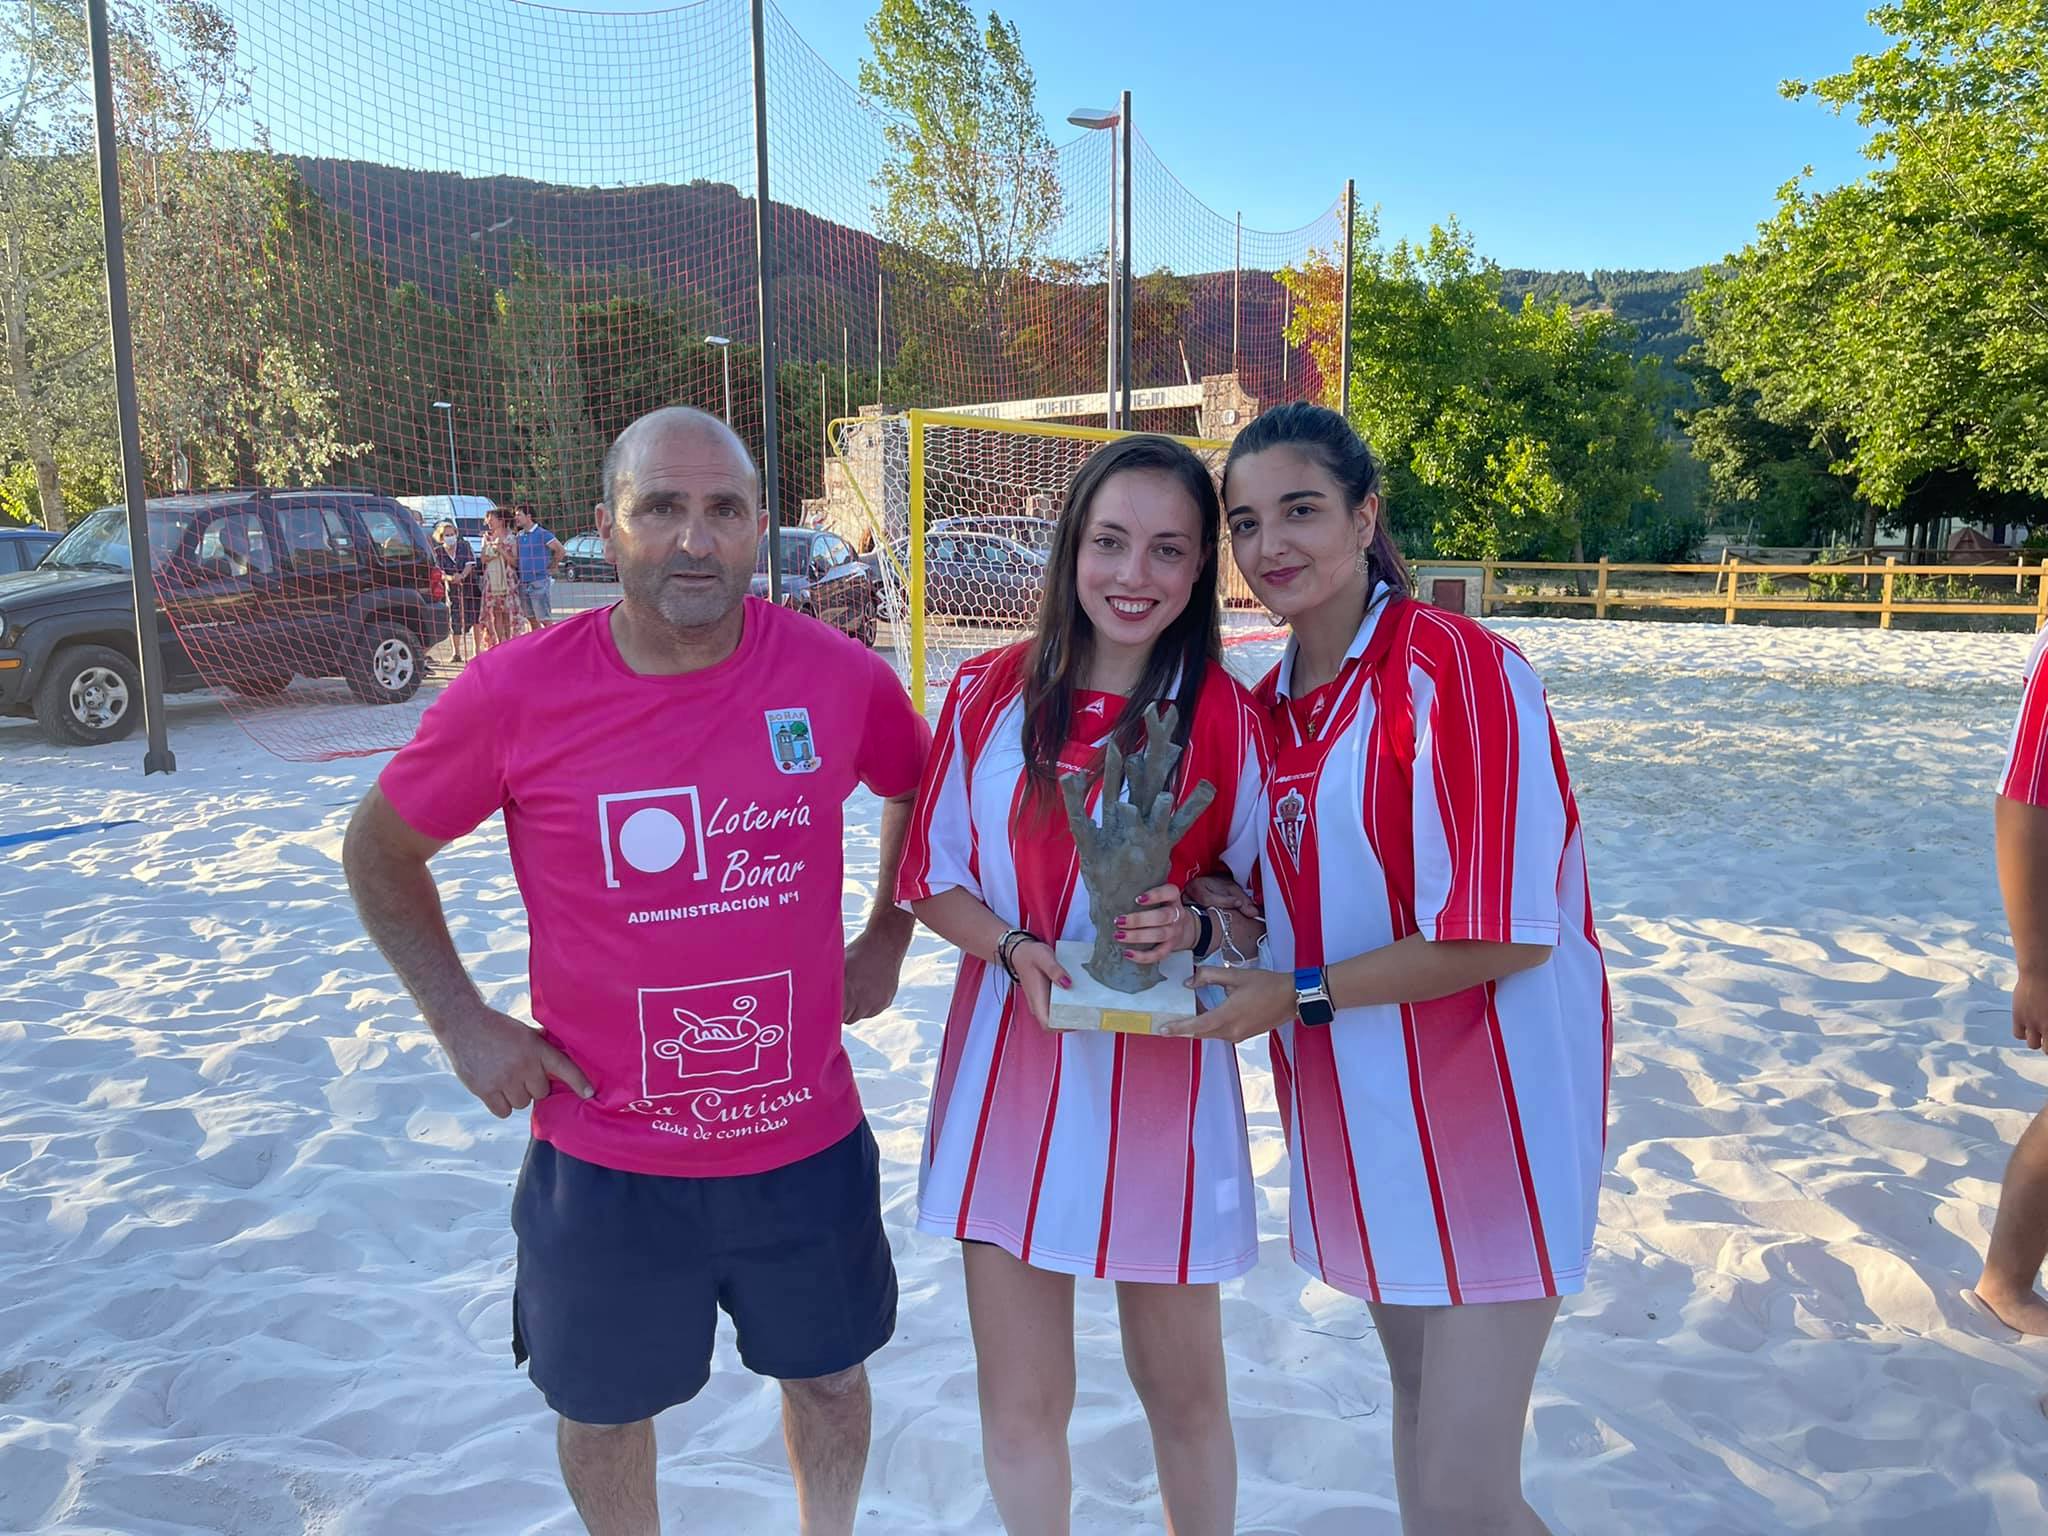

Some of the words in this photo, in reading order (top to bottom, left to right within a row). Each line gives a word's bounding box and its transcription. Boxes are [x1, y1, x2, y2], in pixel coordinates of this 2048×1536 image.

[1035, 399, 1083, 415] PUENTE
[1132, 391, 1166, 408] IEJO
[706, 795, 811, 838] Lotería
[720, 849, 805, 893] Boñar
[628, 895, 770, 924] ADMINISTRACIÓN
[619, 1099, 679, 1116] La
[691, 1087, 813, 1122] Curiosa
[651, 1119, 689, 1138] casa
[693, 1124, 712, 1140] de
[716, 1117, 788, 1139] comidas
